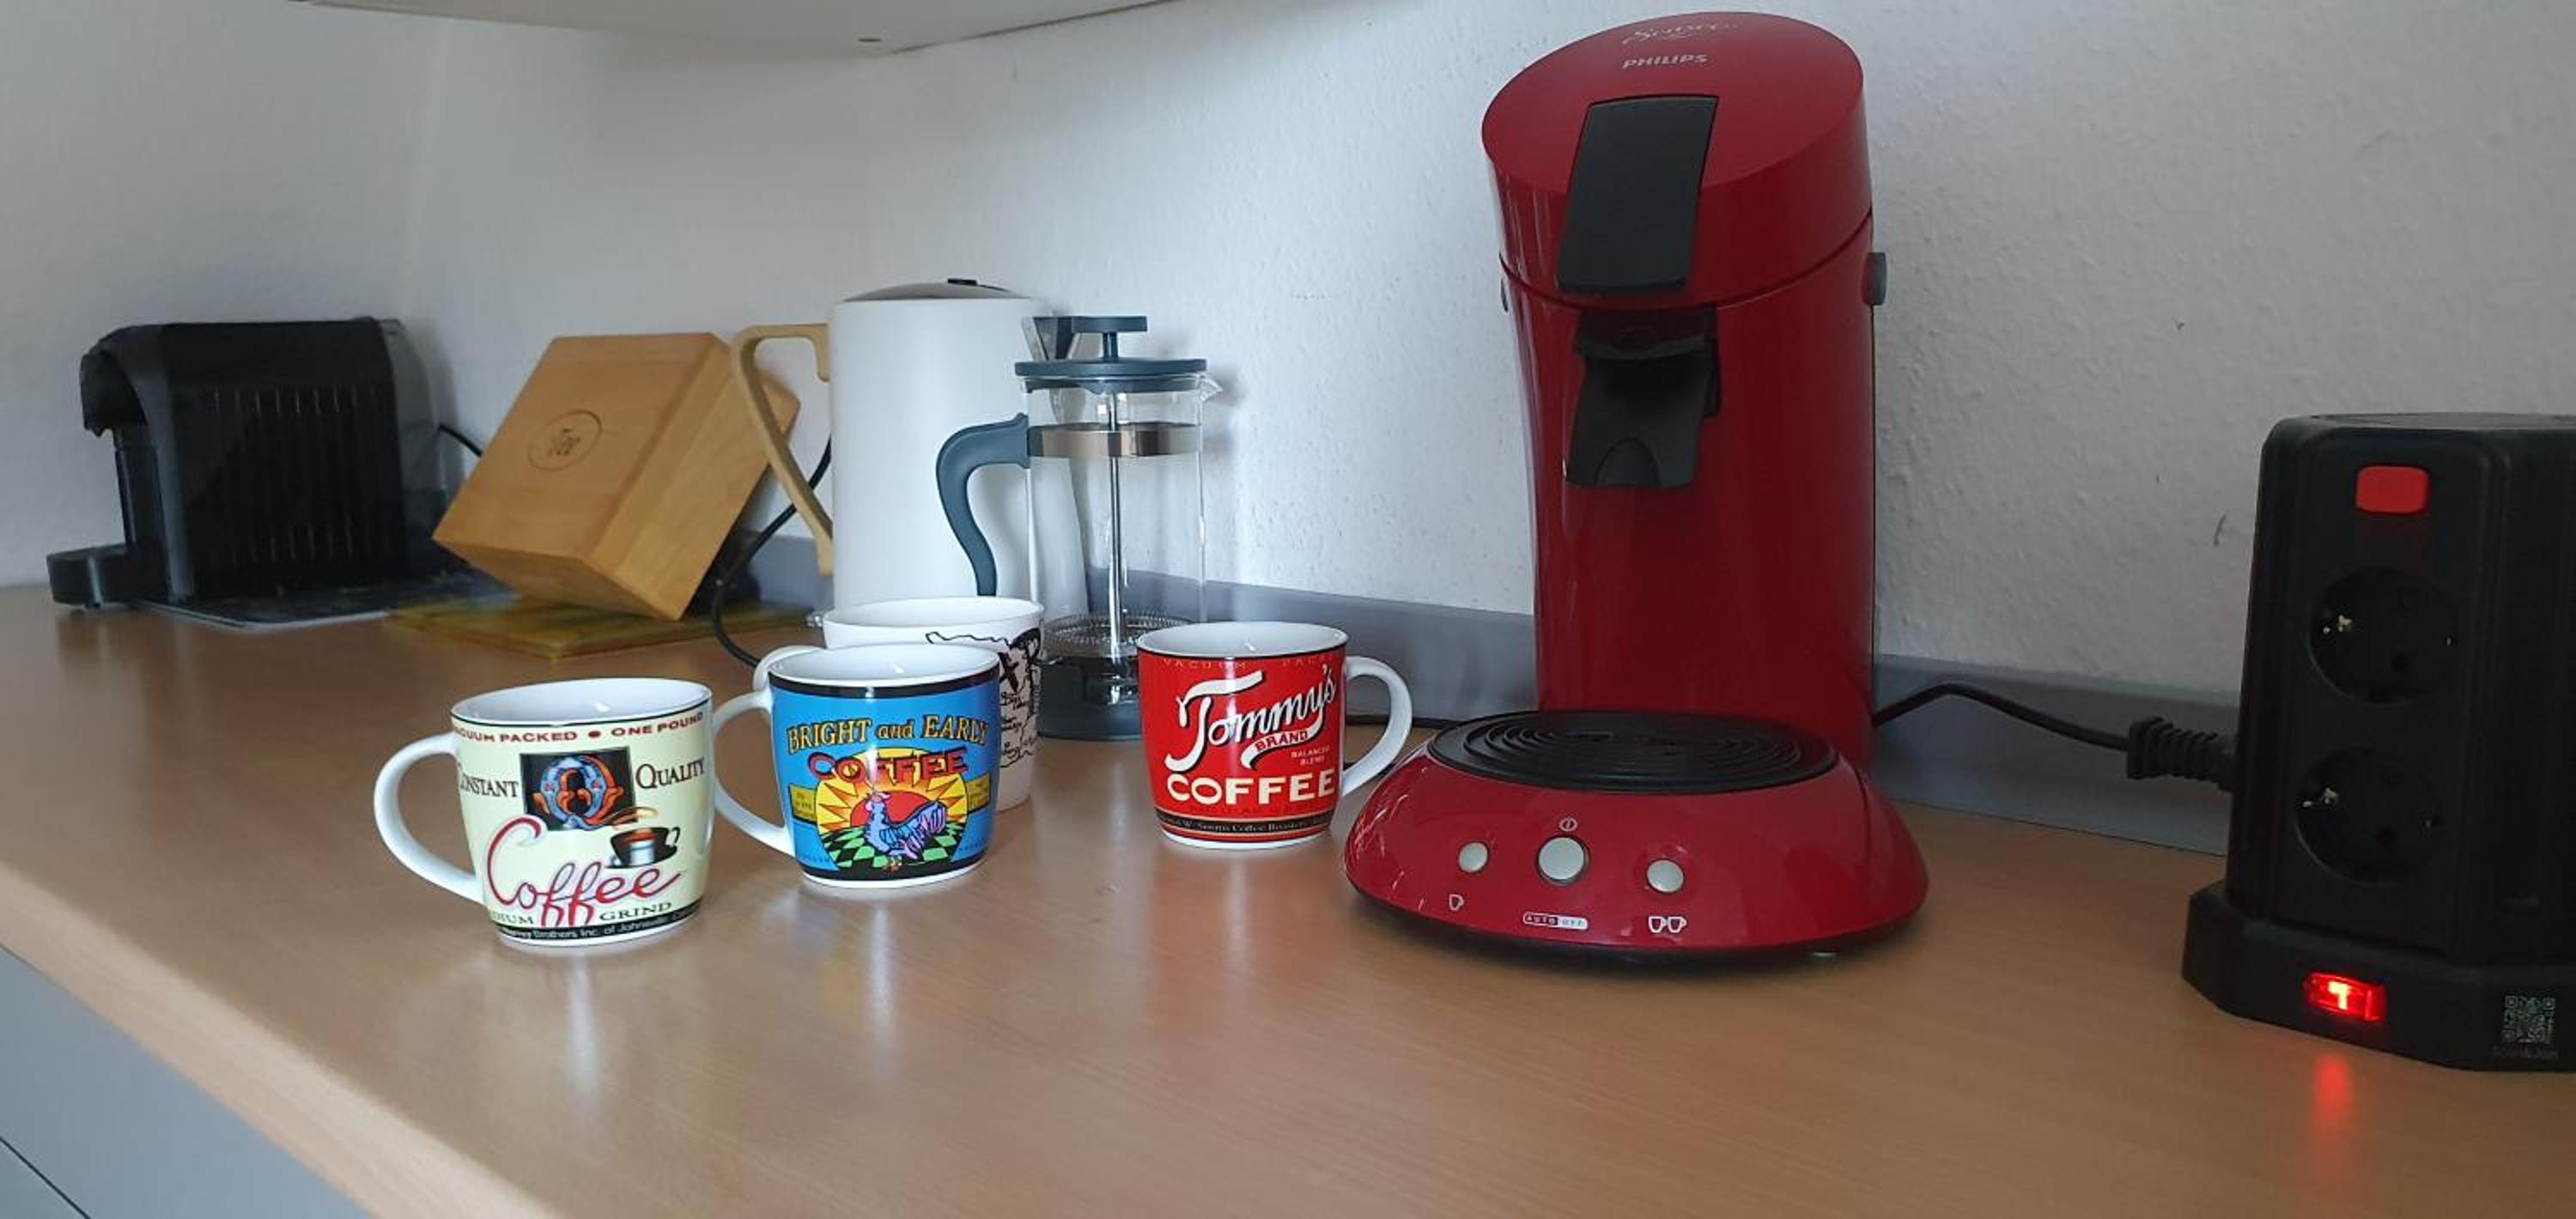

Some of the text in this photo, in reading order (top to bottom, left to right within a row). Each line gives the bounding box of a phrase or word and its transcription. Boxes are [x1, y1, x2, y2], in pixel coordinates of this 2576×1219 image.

[1621, 53, 1709, 70] PHILIPS
[499, 731, 578, 743] PACKED
[611, 725, 653, 737] ONE
[657, 712, 704, 734] POUND
[787, 718, 872, 755] BRIGHT
[874, 716, 915, 741] and
[922, 713, 990, 746] EARLY
[1164, 664, 1336, 773] Tommy's
[1255, 730, 1308, 752] BRAND
[636, 756, 705, 789] QUALITY
[807, 747, 969, 784] COFFEE
[1166, 768, 1336, 805] COFFEE
[487, 814, 682, 928] Coffee
[599, 902, 671, 921] GRIND
